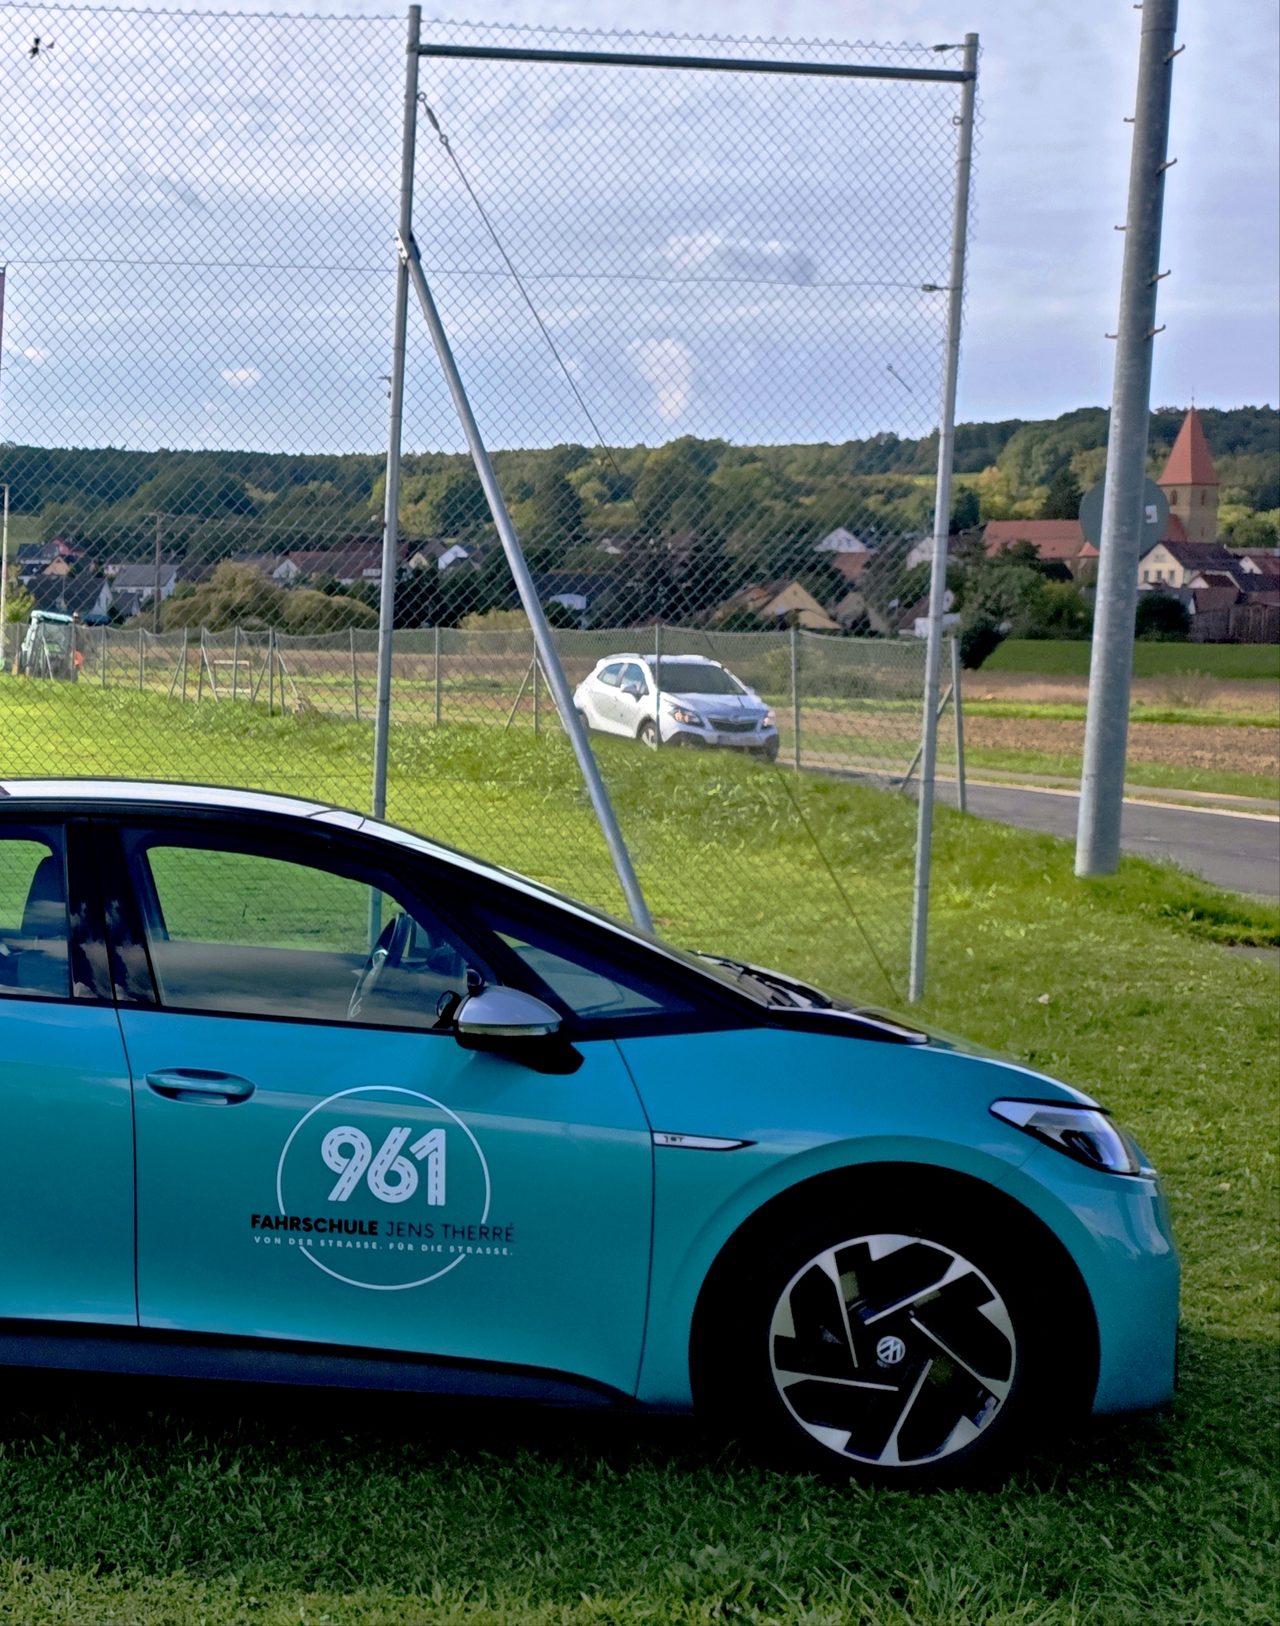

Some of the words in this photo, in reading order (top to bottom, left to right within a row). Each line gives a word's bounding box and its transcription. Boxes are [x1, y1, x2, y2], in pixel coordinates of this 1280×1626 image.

[320, 1125, 447, 1207] 961
[250, 1213, 379, 1237] FAHRSCHULE
[385, 1221, 435, 1240] JENS
[440, 1222, 516, 1243] THERRÉ
[253, 1236, 282, 1245] VON
[288, 1238, 313, 1247] DER
[319, 1239, 383, 1250] STRASSE.
[388, 1241, 415, 1252] FÜR
[420, 1243, 443, 1253] DIE
[449, 1245, 514, 1256] STRASSE.
